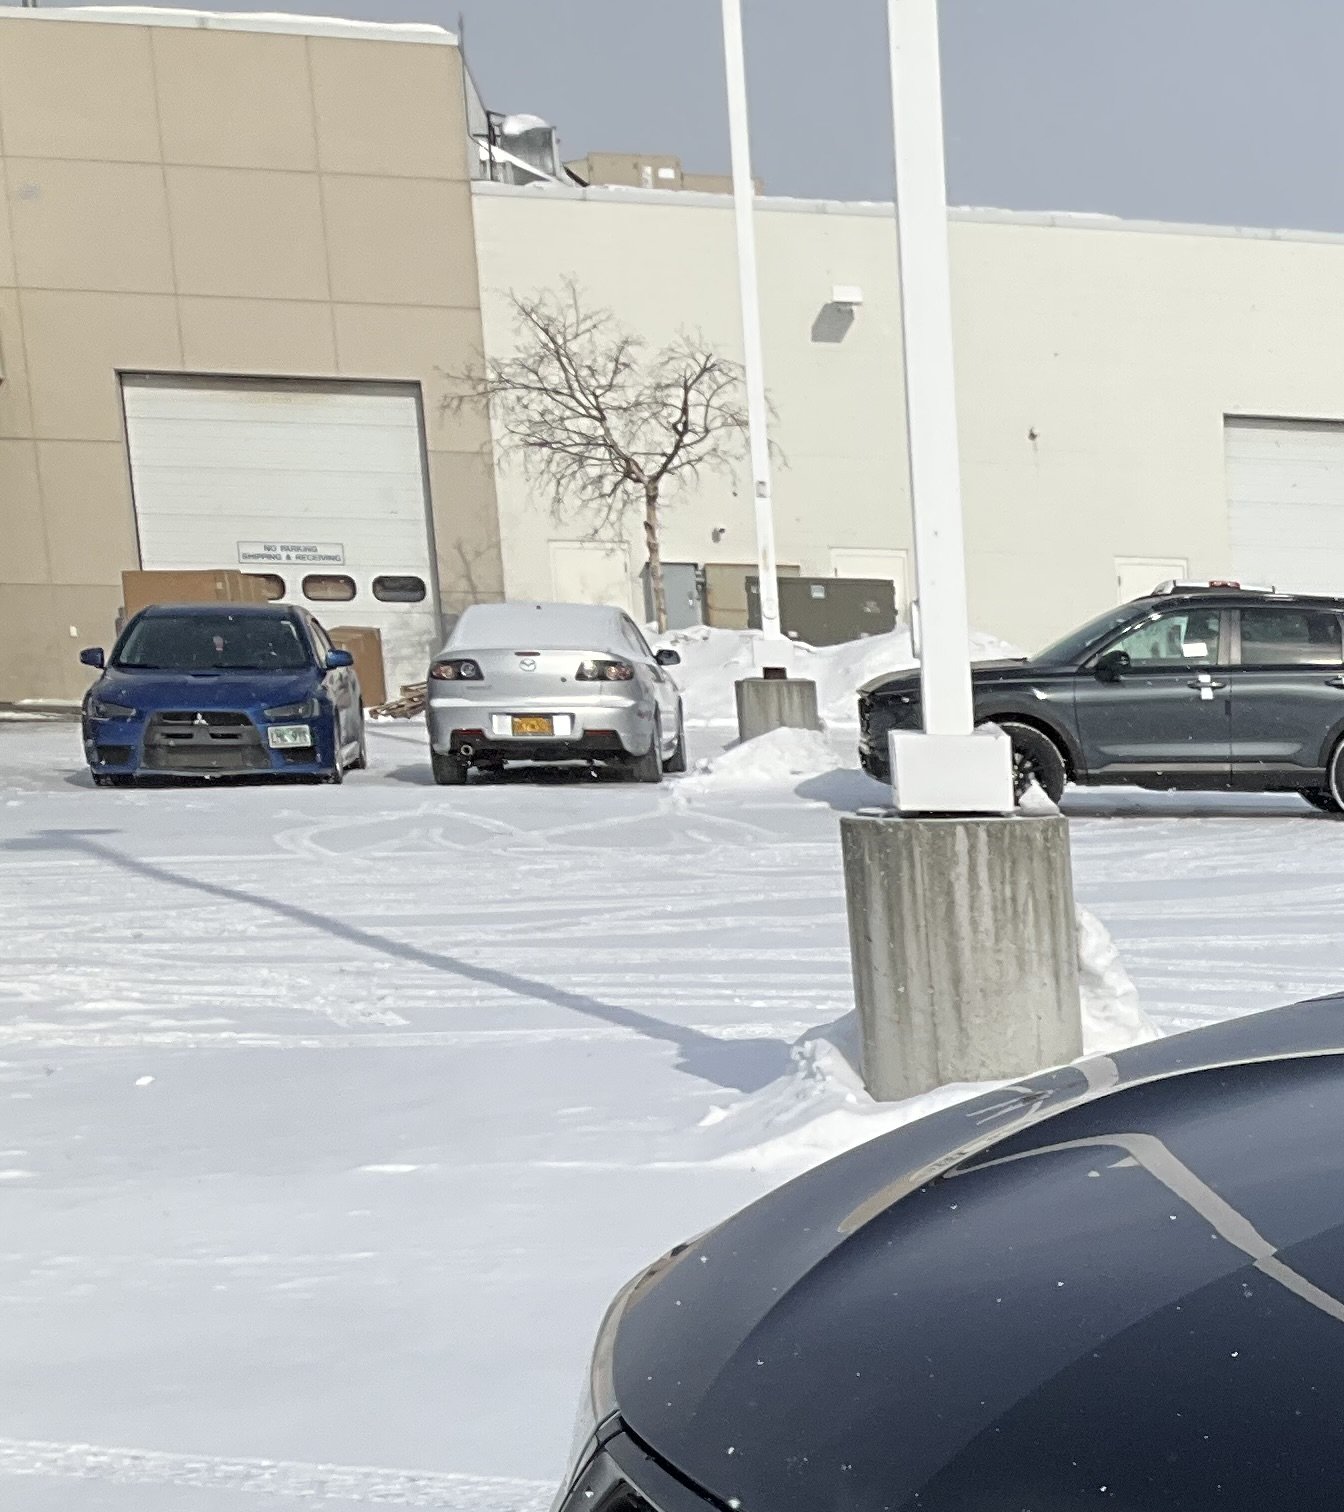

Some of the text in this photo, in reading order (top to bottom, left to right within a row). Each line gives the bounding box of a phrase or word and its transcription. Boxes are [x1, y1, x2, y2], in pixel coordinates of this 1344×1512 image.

[263, 544, 318, 553] NO PARKING
[242, 552, 282, 561] SHIPPING
[295, 553, 342, 562] RECEIVING
